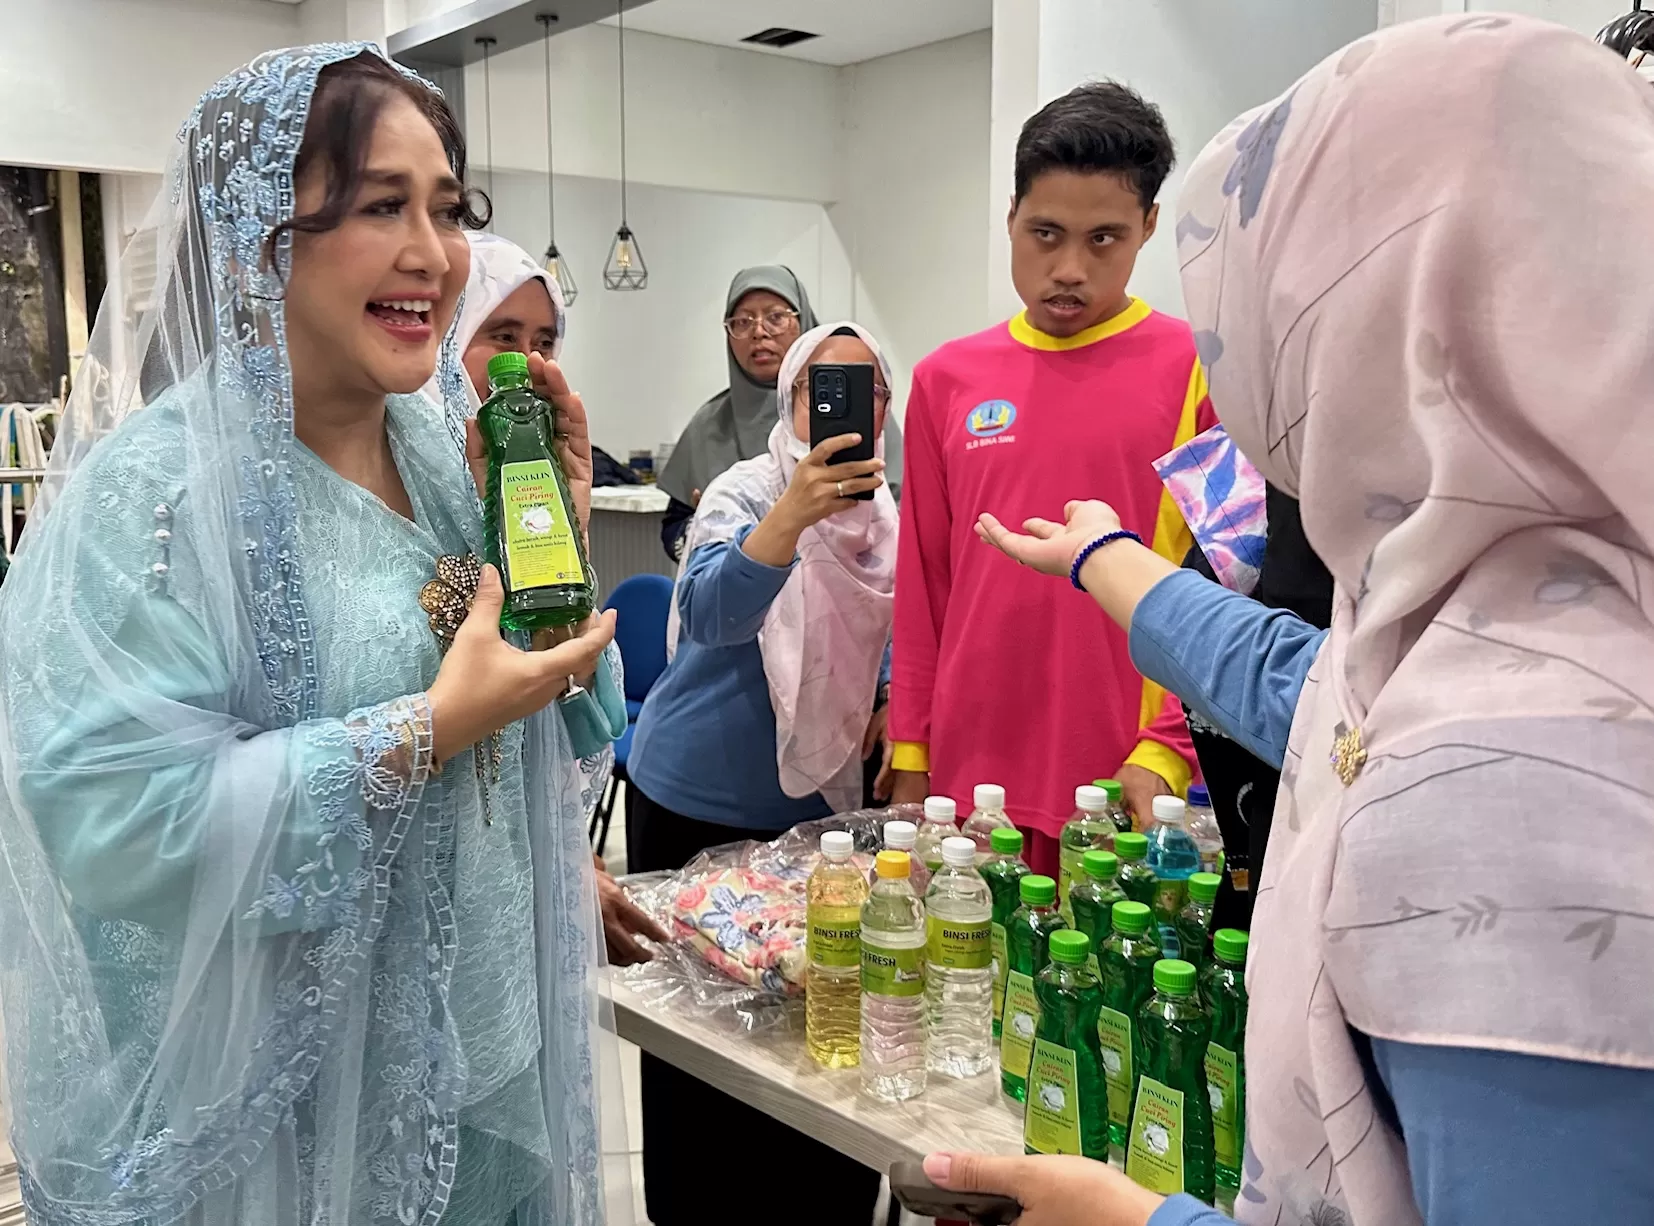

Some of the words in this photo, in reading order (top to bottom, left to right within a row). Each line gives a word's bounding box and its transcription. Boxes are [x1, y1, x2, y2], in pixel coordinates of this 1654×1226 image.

[516, 485, 543, 493] Cairan
[510, 494, 529, 502] Cuci
[529, 492, 554, 501] Piring
[813, 926, 837, 938] BINSI
[943, 929, 969, 940] BINSI
[868, 952, 896, 966] FRESH
[1140, 1104, 1156, 1116] Cuci
[1156, 1110, 1177, 1129] Piring
